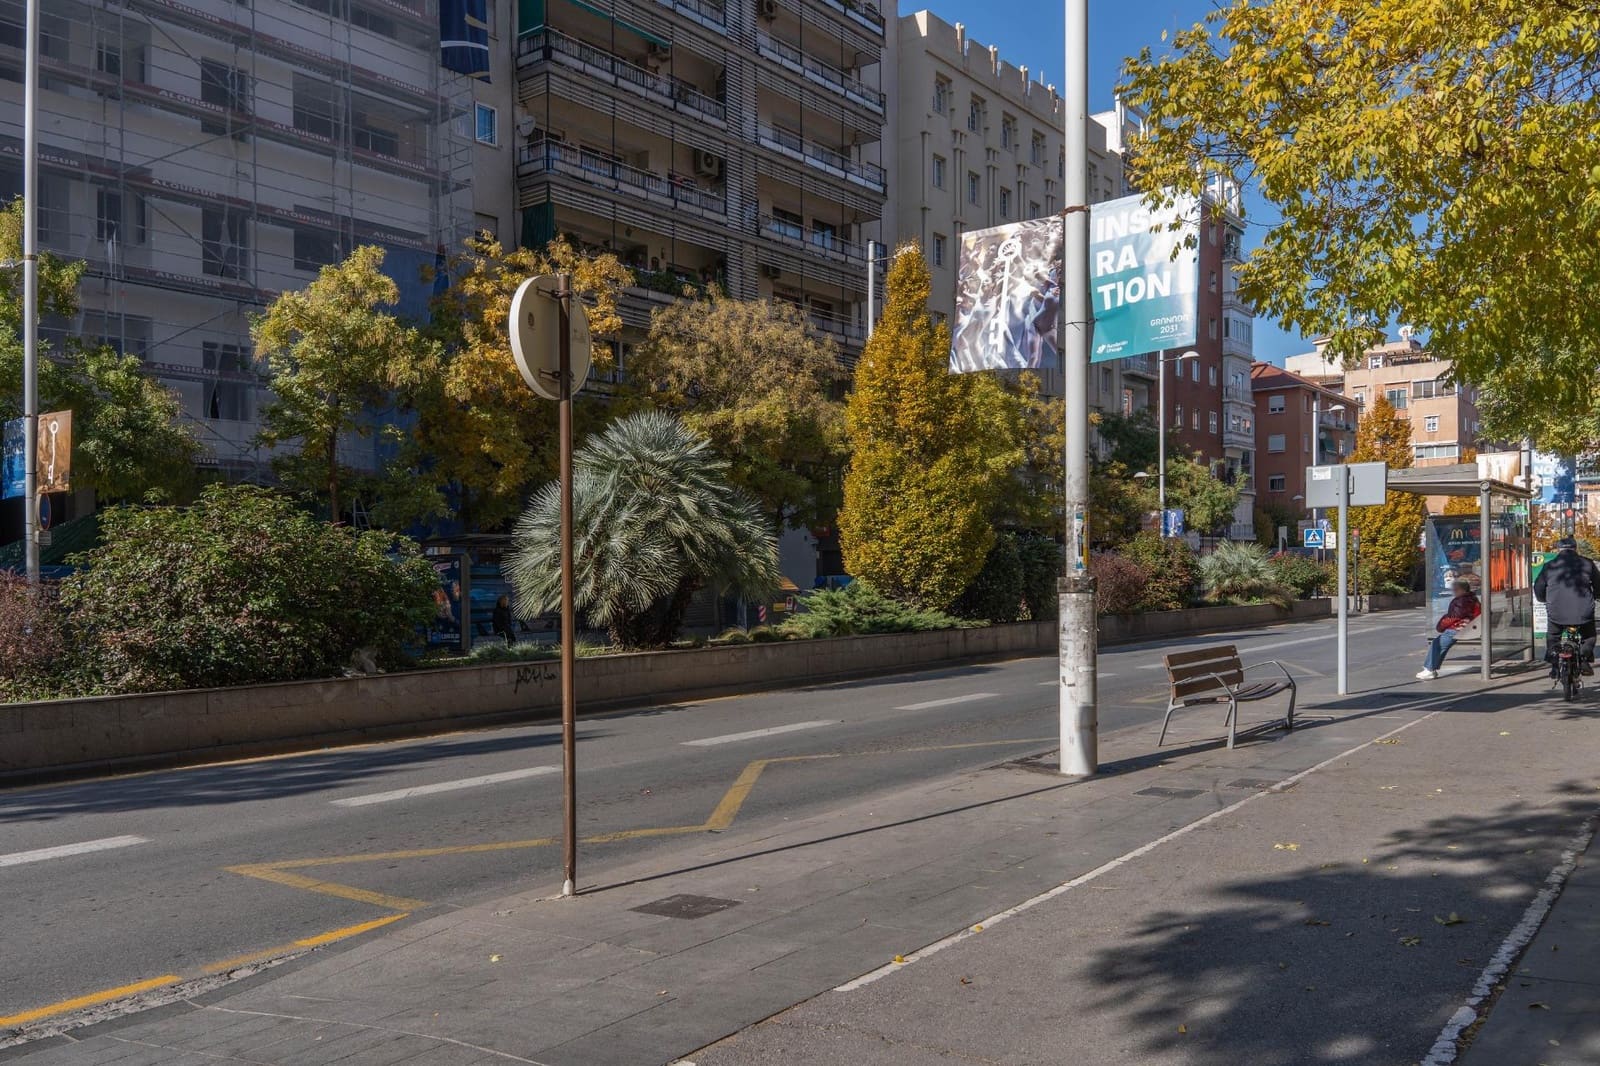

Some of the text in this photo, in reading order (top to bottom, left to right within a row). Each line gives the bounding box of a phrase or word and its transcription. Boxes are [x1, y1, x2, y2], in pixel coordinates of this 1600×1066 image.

[2, 146, 79, 167] ALUISUR
[1097, 208, 1150, 243] INS
[1096, 244, 1139, 277] RA
[1097, 271, 1171, 310] TION
[1160, 324, 1178, 334] 2031
